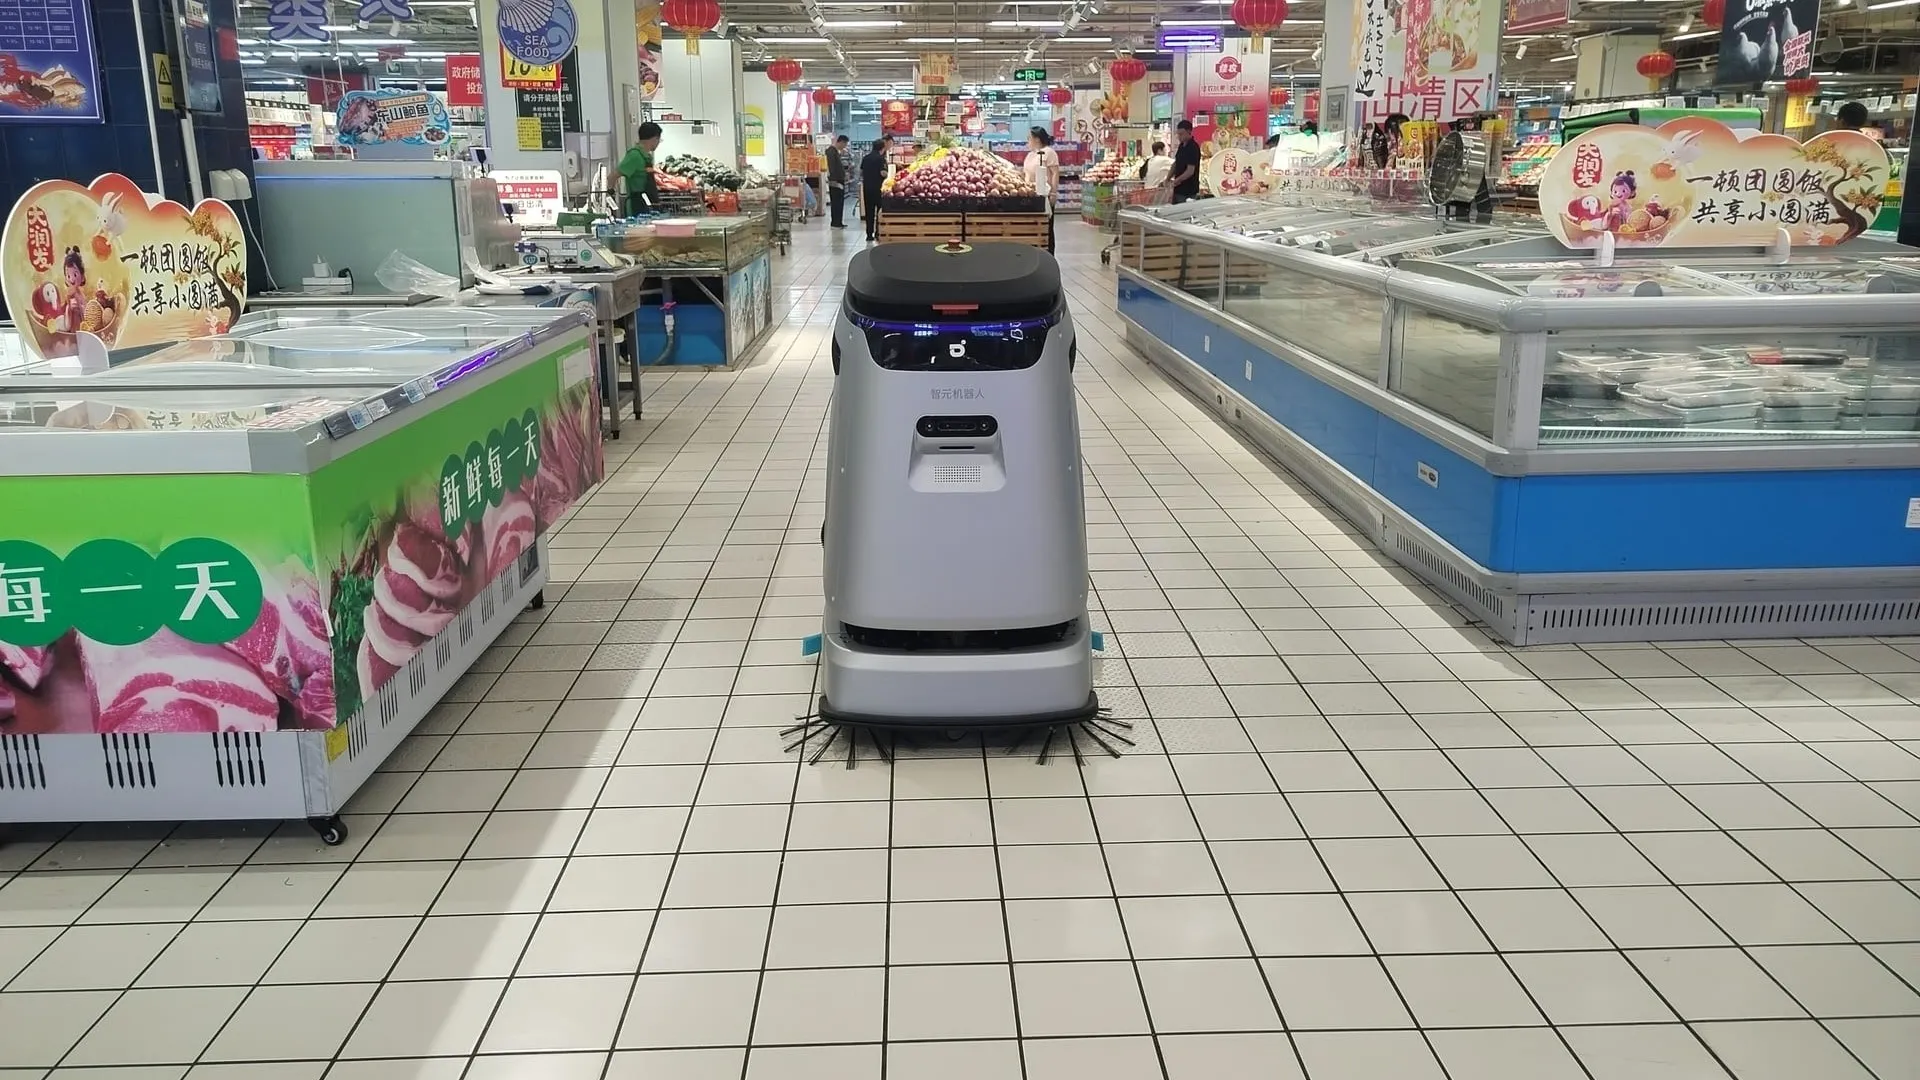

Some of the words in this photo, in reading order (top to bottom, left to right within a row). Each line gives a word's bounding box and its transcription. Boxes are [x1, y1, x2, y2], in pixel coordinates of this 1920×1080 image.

[517, 46, 550, 58] FOOD
[524, 35, 549, 46] SEA
[1375, 14, 1384, 78] HAPPY
[1373, 75, 1485, 120] 出清区
[1575, 143, 1602, 188] 大润发
[1686, 167, 1827, 194] 一顿团圆饭
[1691, 197, 1830, 226] 共享小圆满
[27, 207, 51, 271] 大润发
[120, 242, 214, 276] 一顿团圆饭
[131, 278, 221, 317] 共享小圆满
[931, 389, 985, 399] 智元机器人
[441, 421, 538, 527] 新鲜每一天
[0, 561, 241, 624] 每一天
